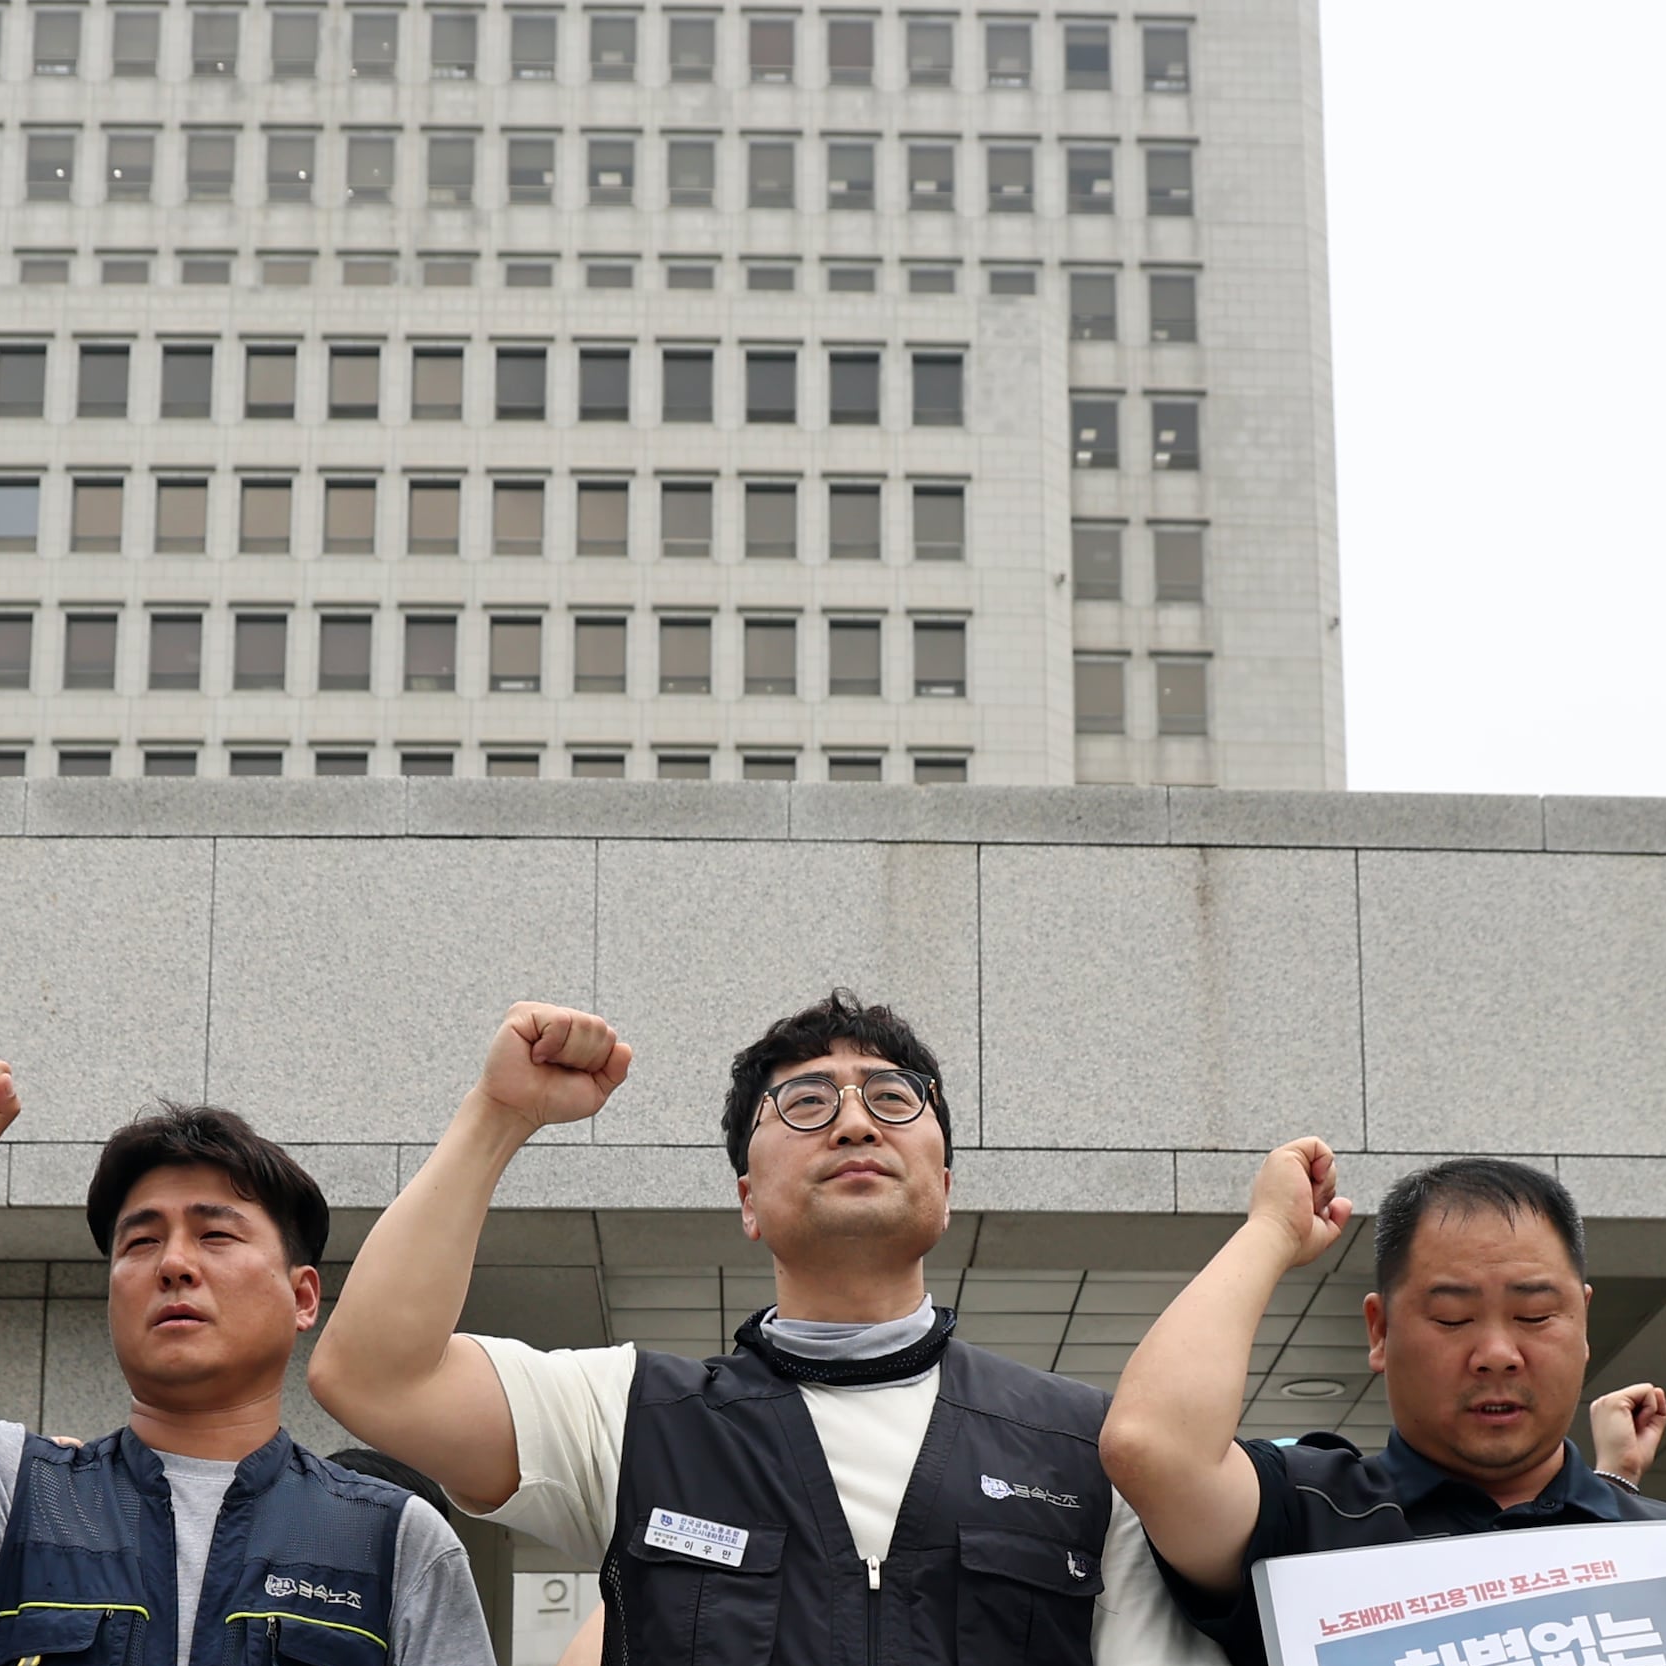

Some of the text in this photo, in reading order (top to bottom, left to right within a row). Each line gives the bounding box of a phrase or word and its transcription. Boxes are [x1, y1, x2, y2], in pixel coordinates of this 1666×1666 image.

[1013, 1483, 1082, 1508] 금속노조
[298, 1580, 362, 1609] 금속노조
[1319, 1560, 1618, 1637] 노조배제 직고용기만 포스코 규탄!
